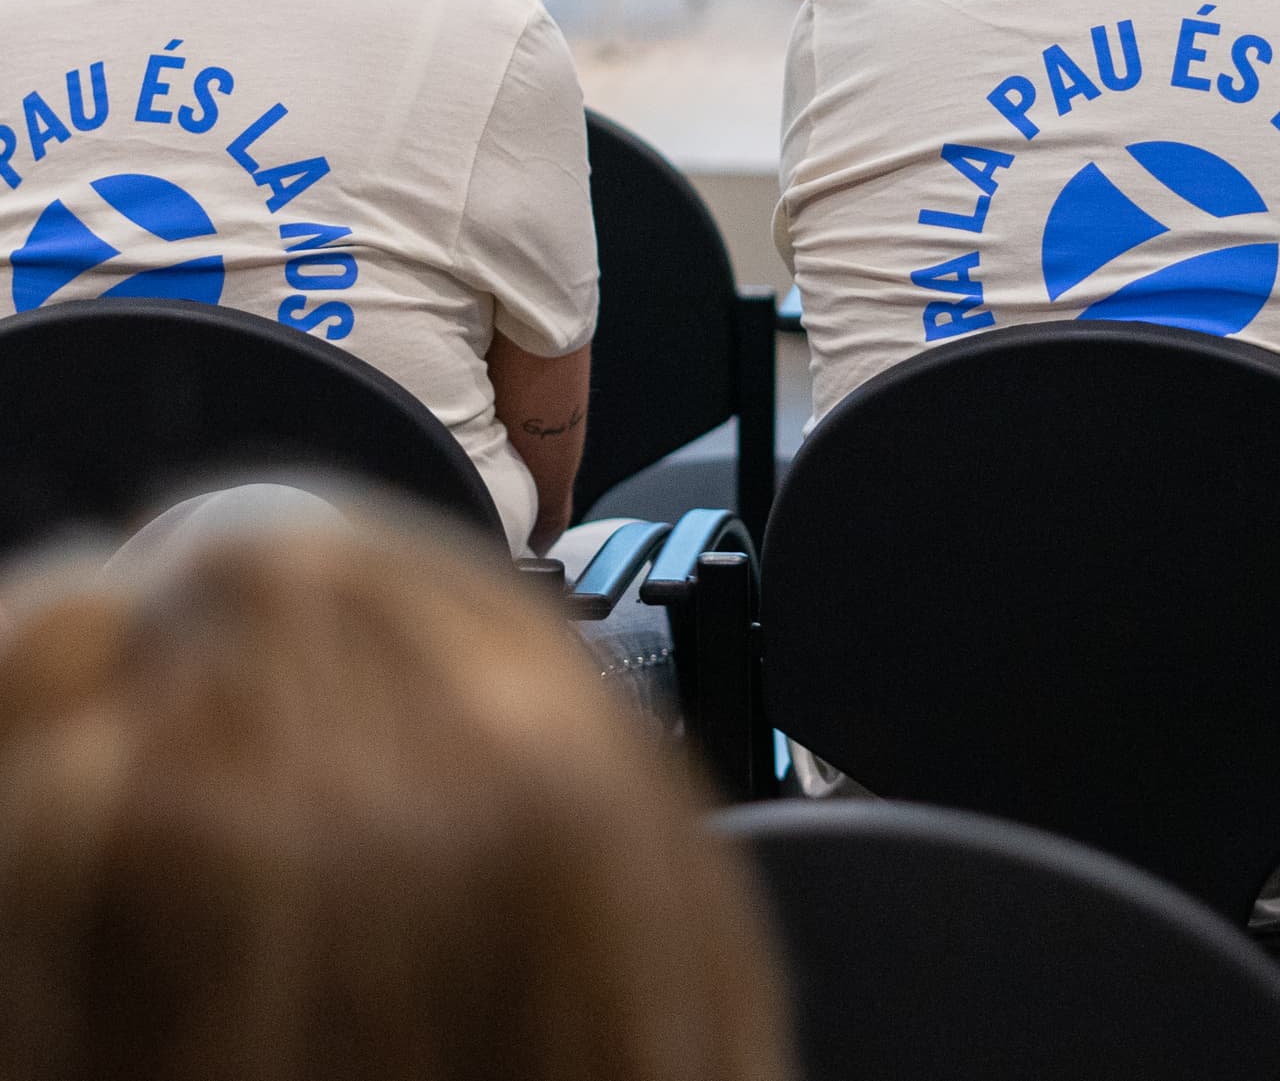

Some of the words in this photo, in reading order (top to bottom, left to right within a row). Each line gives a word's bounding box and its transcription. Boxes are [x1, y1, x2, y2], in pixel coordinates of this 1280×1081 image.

[134, 39, 235, 135] ÉS
[226, 102, 331, 214] LA
[917, 143, 1015, 233] LA
[986, 19, 1143, 141] PAU
[1170, 3, 1273, 104] ÉS
